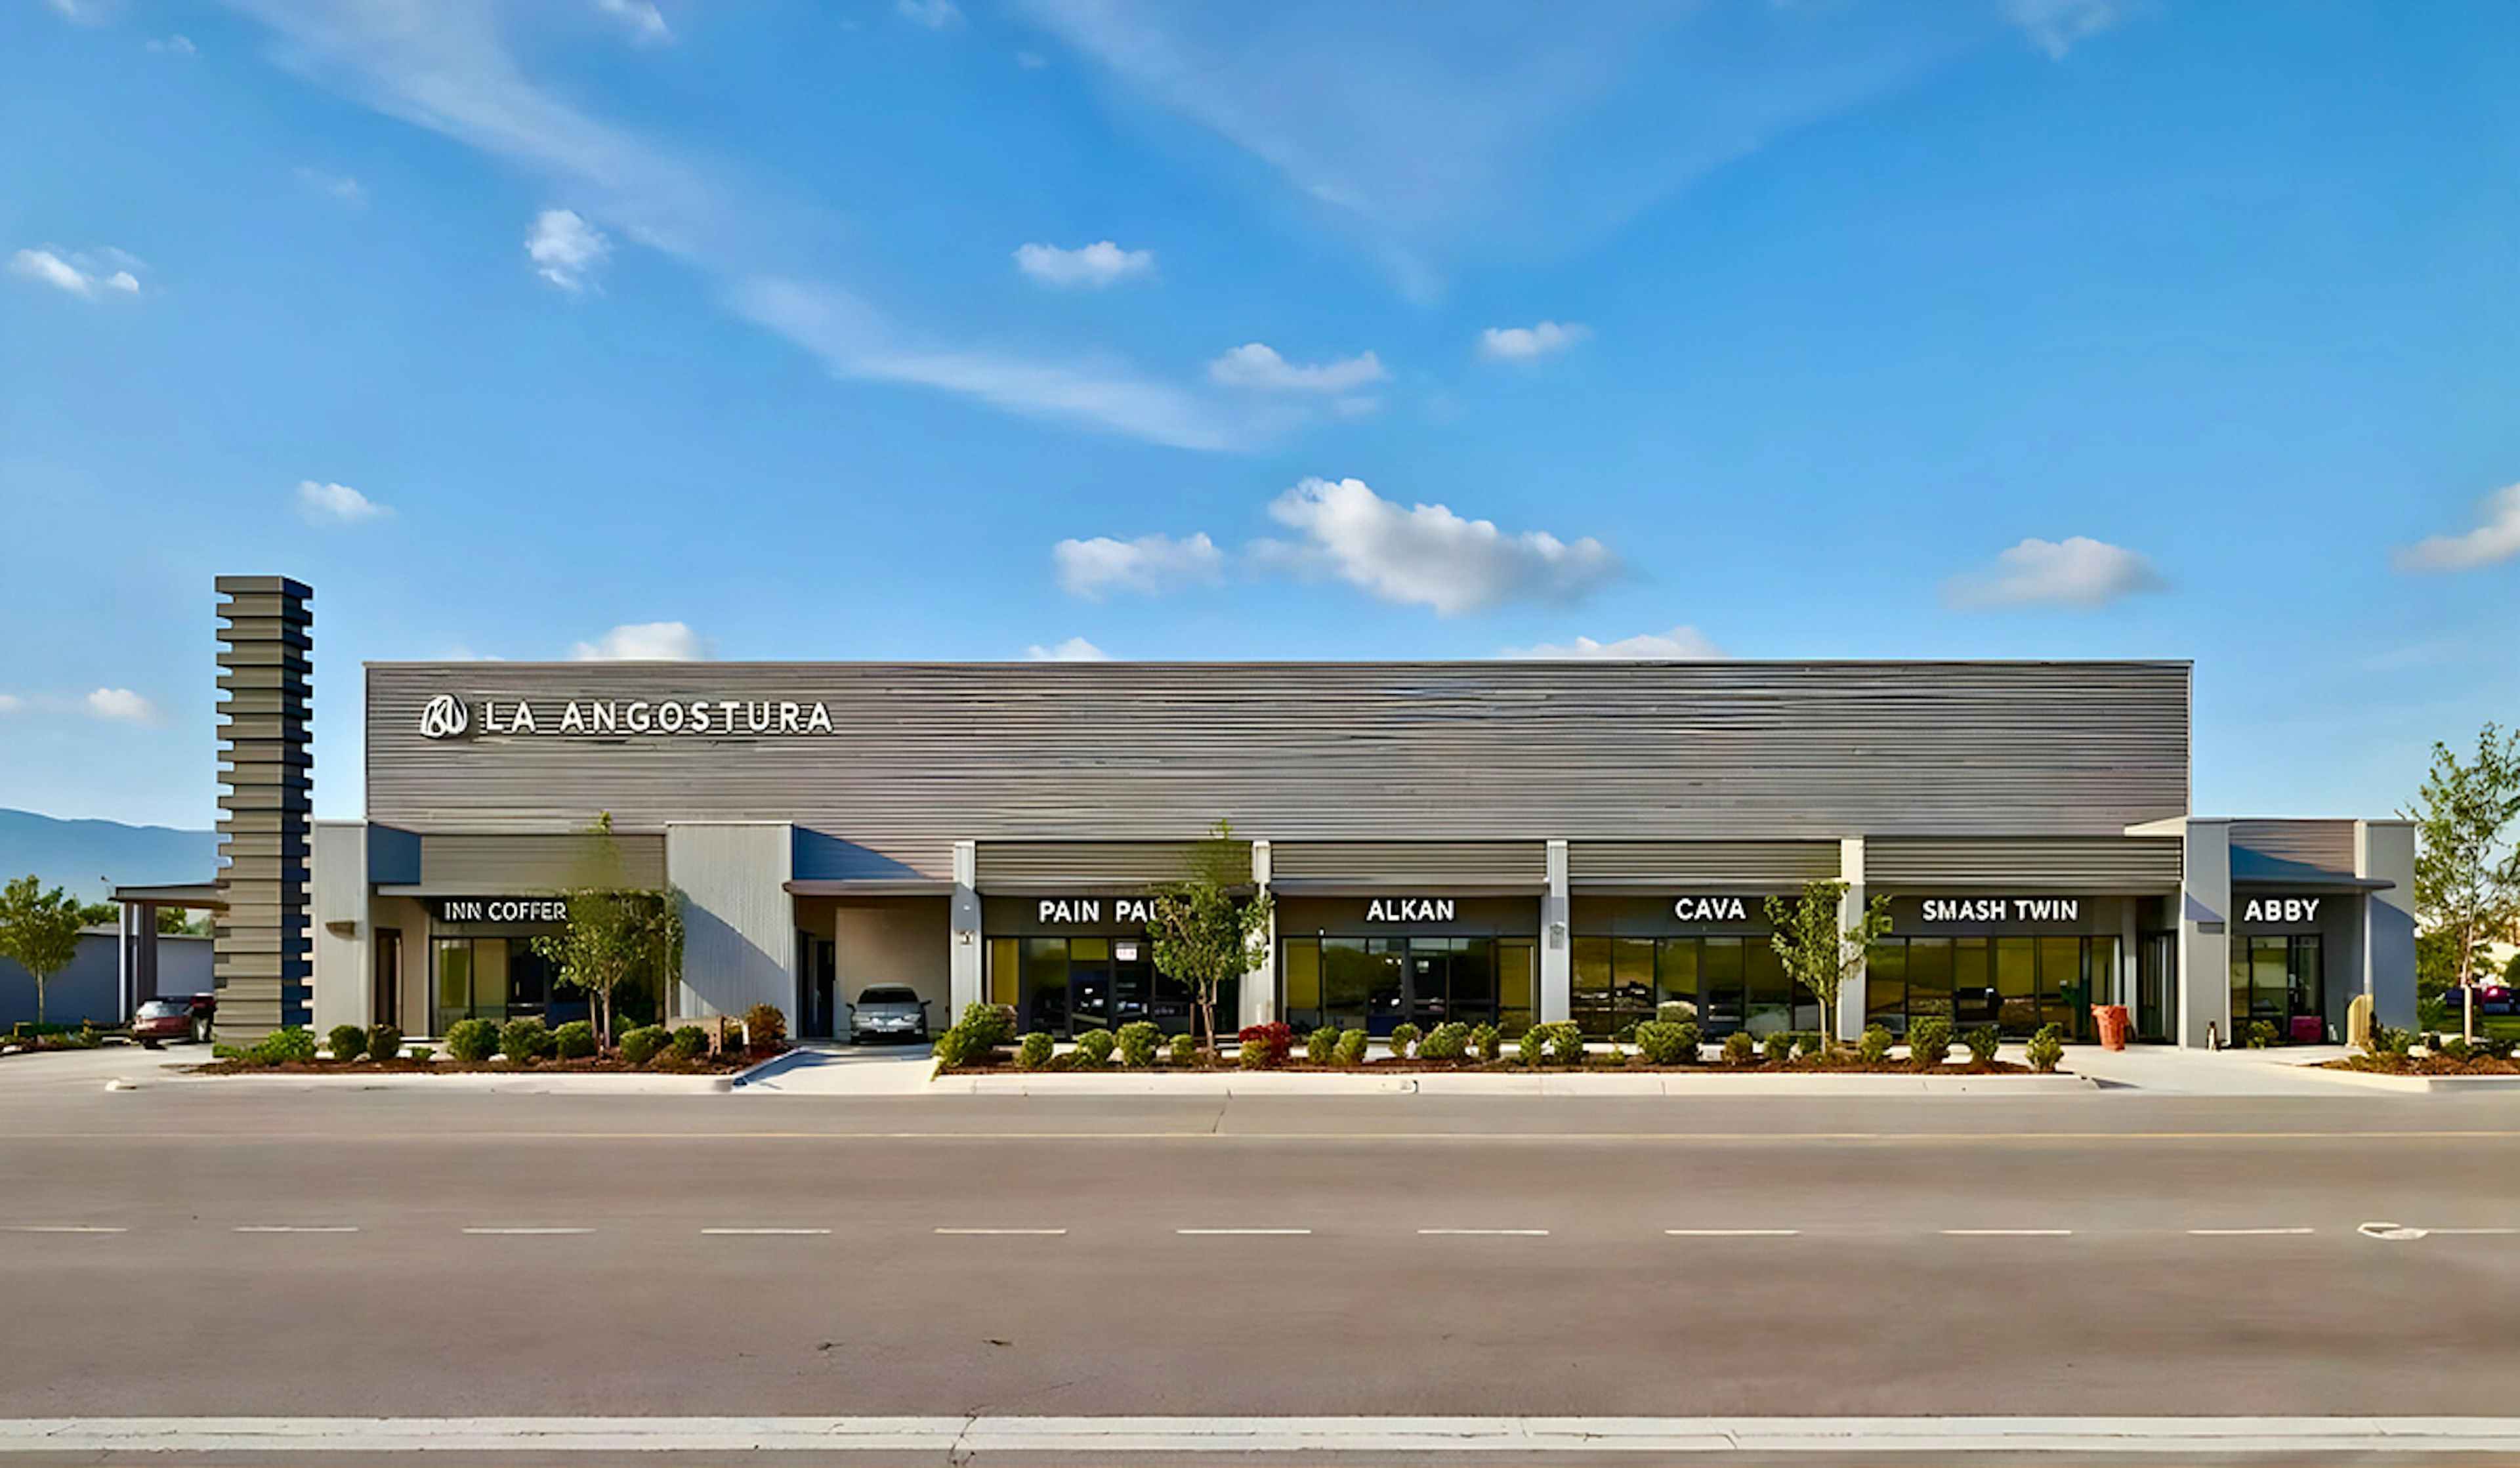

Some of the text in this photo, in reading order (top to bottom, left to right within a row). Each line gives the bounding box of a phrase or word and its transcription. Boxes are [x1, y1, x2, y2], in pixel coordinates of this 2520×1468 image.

[486, 702, 536, 732] LA
[560, 702, 833, 733] ANGOSTURA
[444, 902, 567, 921] INN COFFER
[1040, 900, 1100, 923] PAIN
[1366, 898, 1454, 921] ALKAN
[1675, 898, 1746, 921] CAVA
[1922, 900, 2078, 921] SMASH TWIN
[2244, 898, 2320, 921] ABBY
